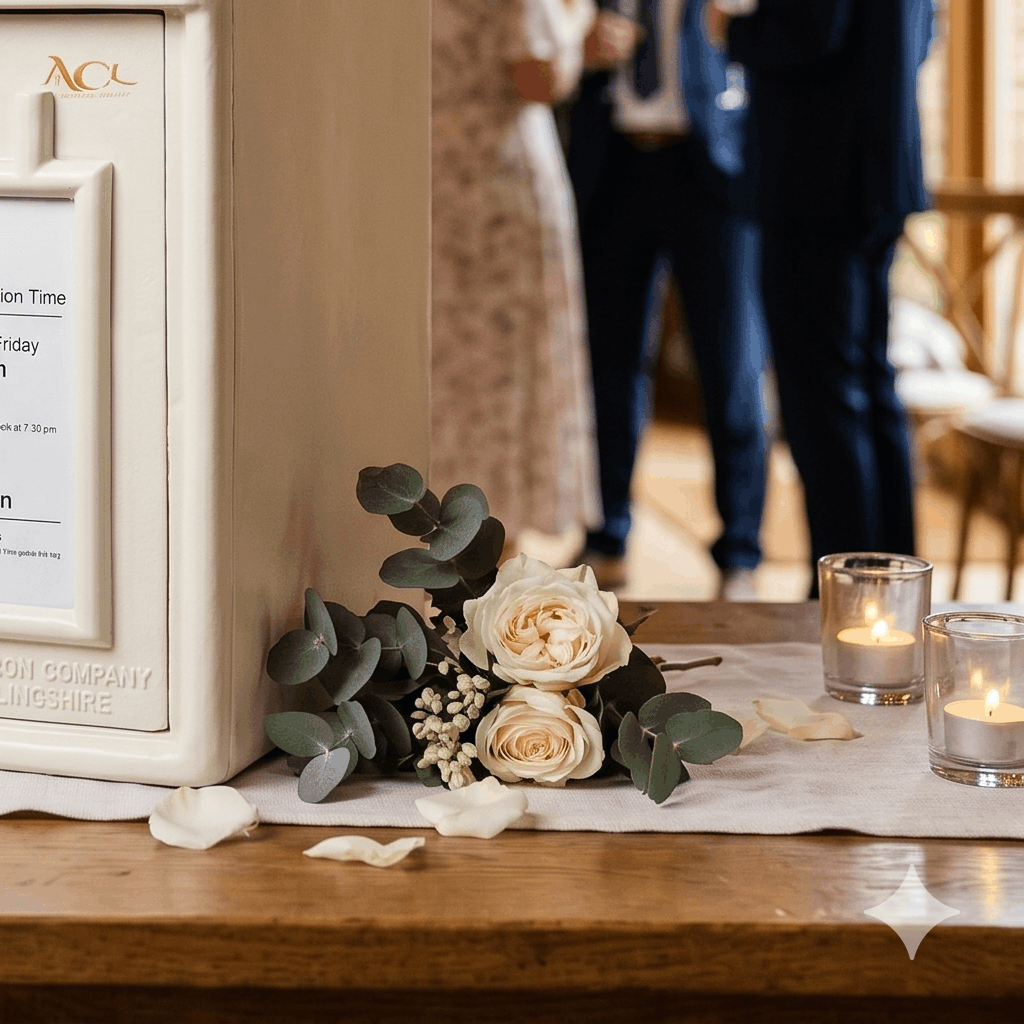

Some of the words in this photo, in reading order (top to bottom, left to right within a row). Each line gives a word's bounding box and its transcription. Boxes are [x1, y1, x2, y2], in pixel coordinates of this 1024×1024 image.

[40, 55, 138, 92] ACL
[28, 288, 67, 306] Time
[13, 423, 22, 432] at
[31, 423, 42, 433] 30
[43, 425, 57, 435] pm
[43, 659, 153, 690] COMPANY
